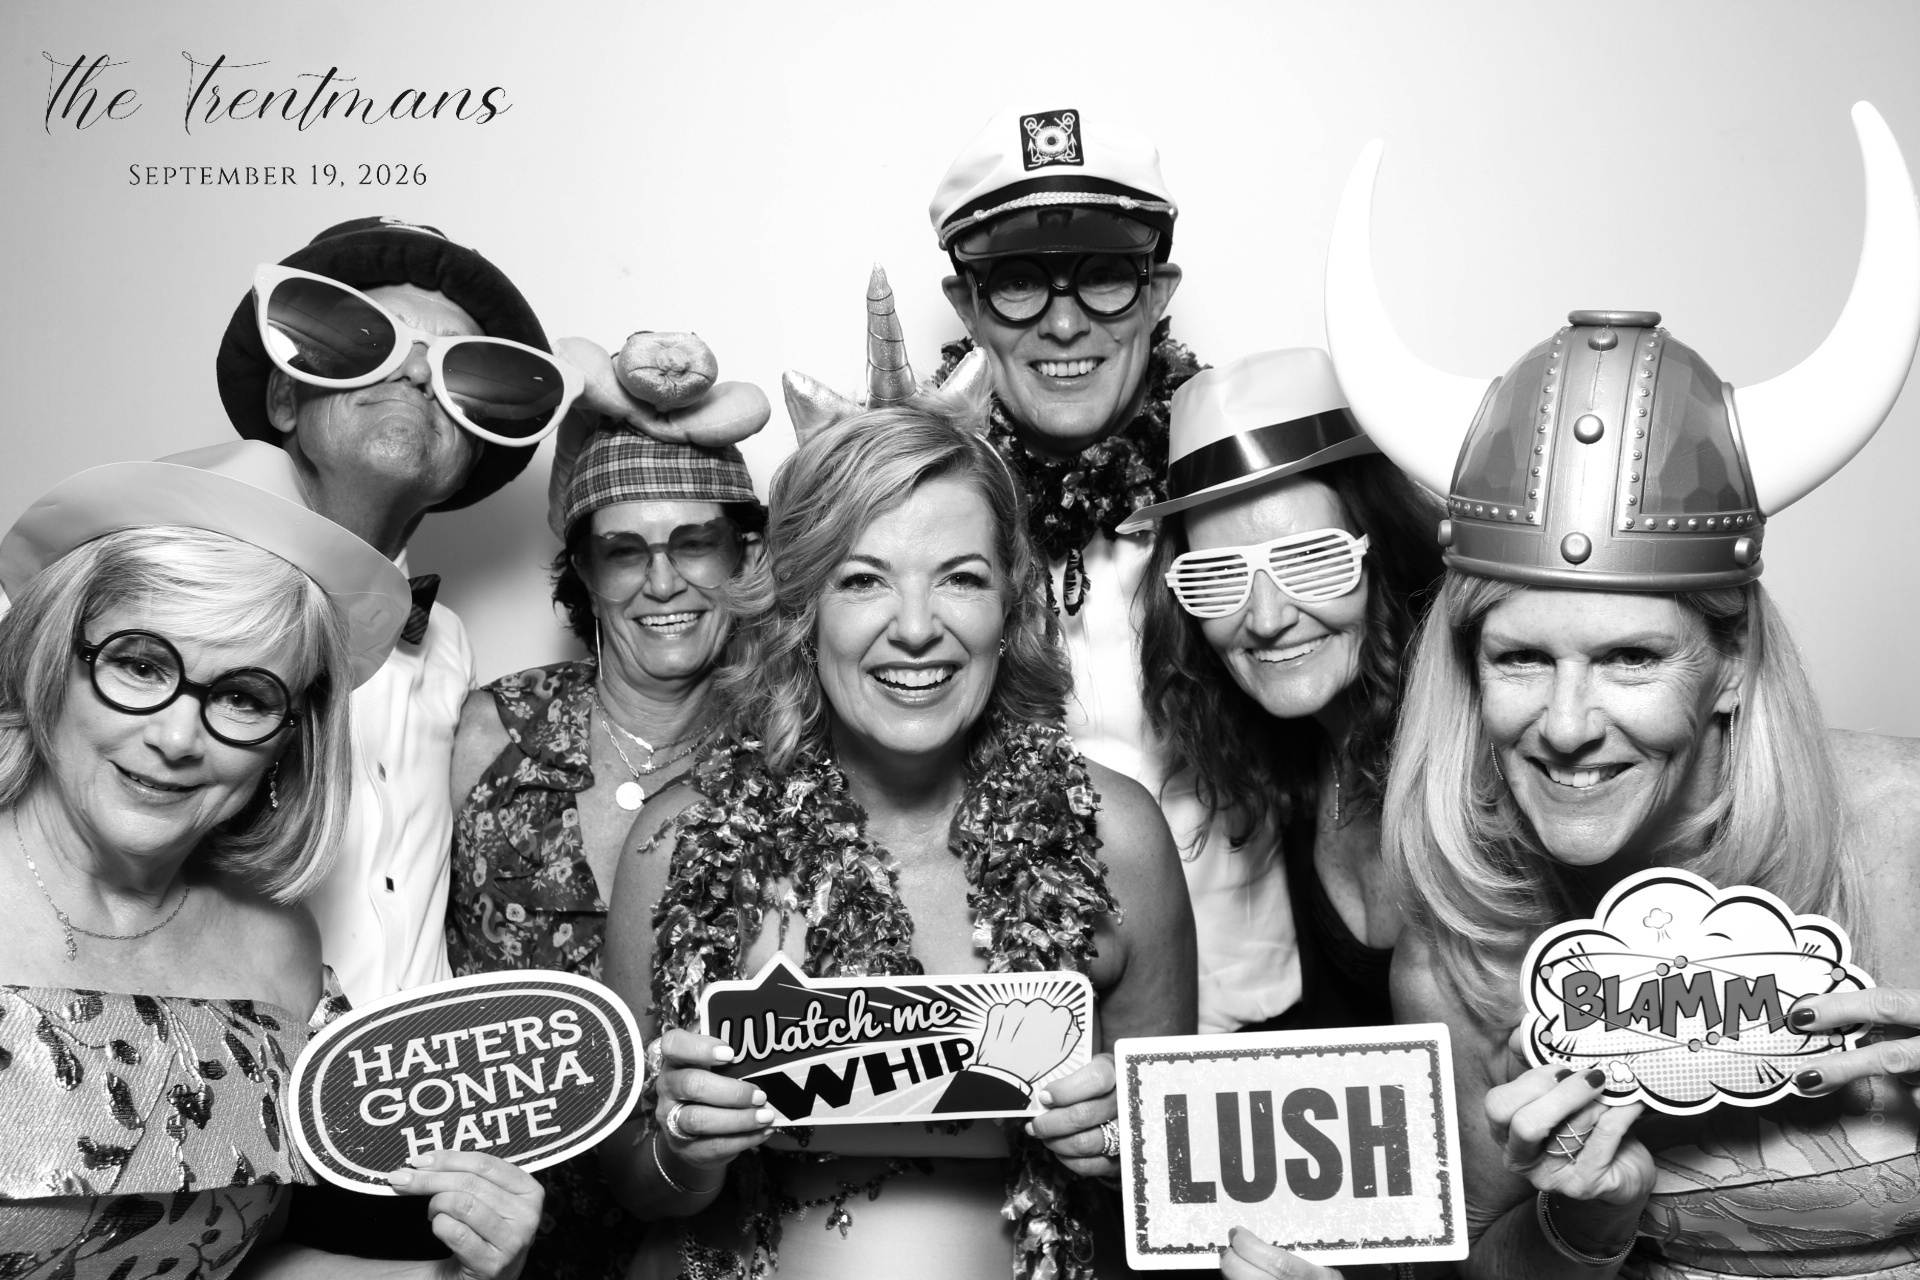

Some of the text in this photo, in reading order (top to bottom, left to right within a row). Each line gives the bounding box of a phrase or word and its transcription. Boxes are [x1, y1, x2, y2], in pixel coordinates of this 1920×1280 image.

[719, 989, 959, 1064] Watch me
[1562, 970, 1822, 1041] BLAMM
[349, 1009, 583, 1087] HATERS
[741, 1038, 975, 1121] WHIP
[360, 1050, 594, 1126] GONNA
[400, 1098, 561, 1164] HATE
[1164, 1084, 1413, 1204] LUSH
